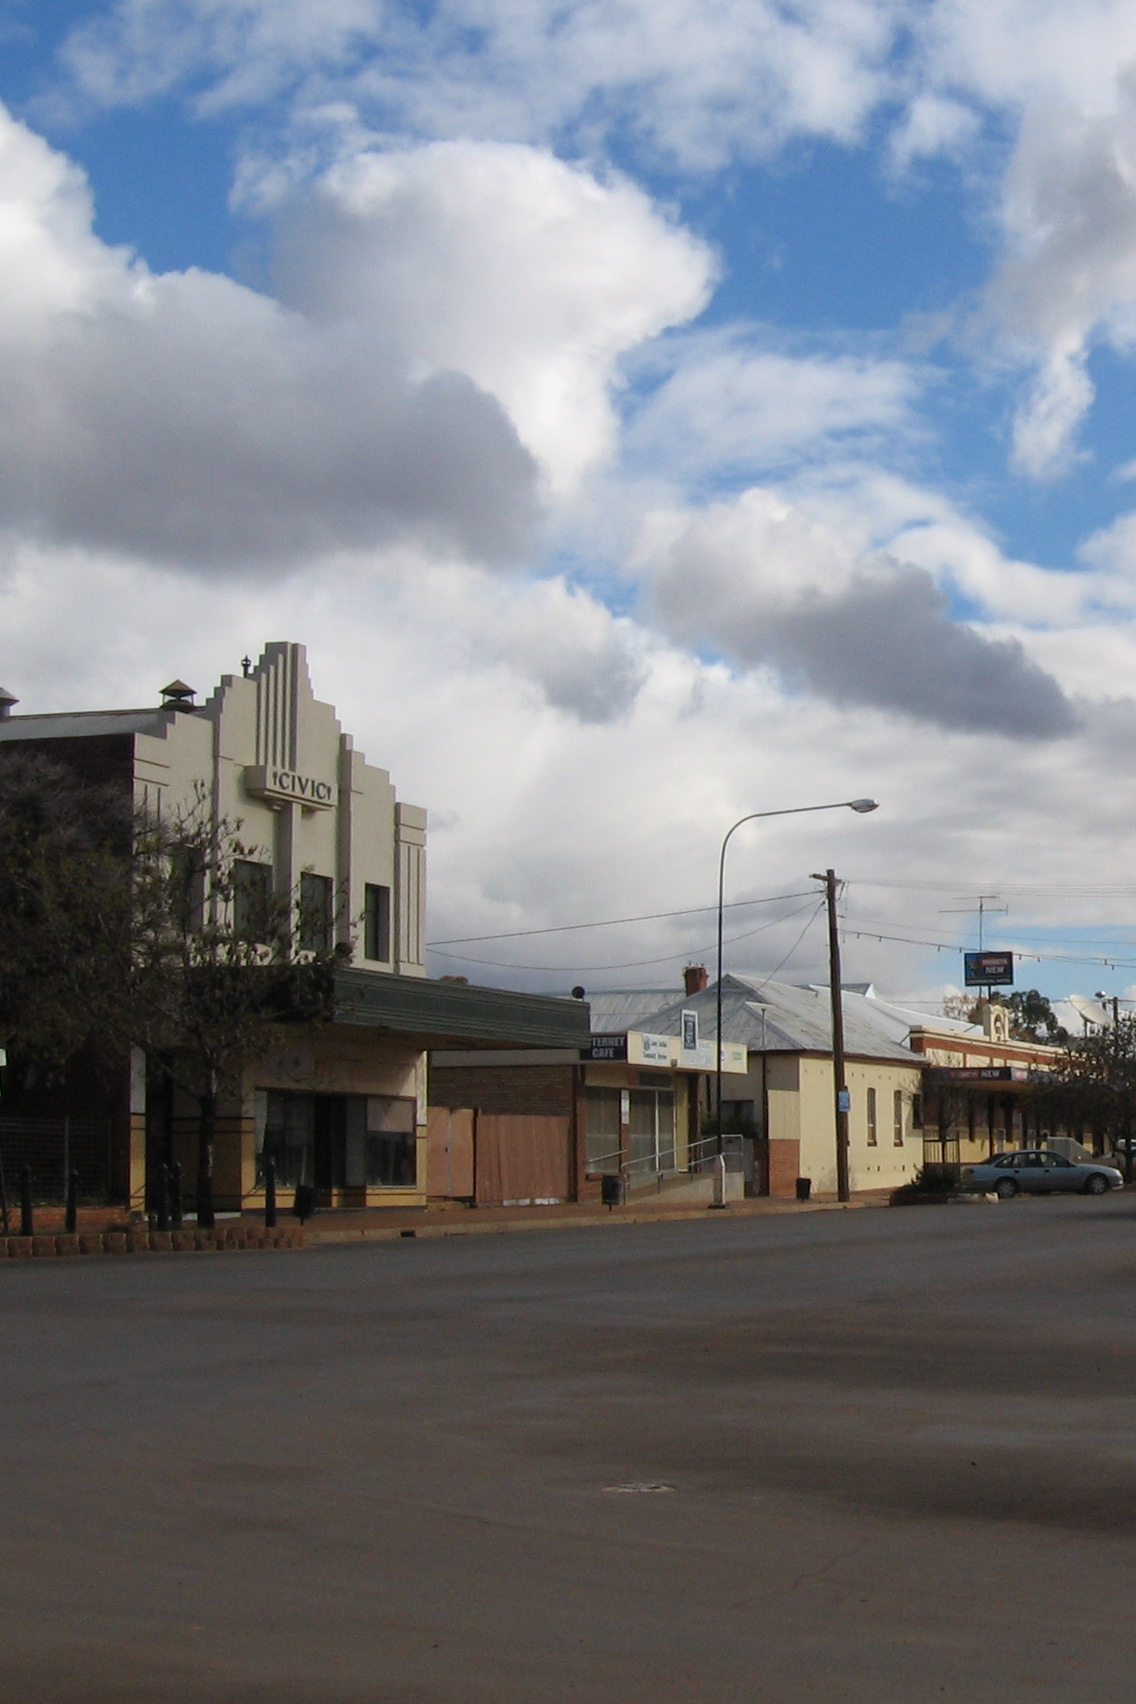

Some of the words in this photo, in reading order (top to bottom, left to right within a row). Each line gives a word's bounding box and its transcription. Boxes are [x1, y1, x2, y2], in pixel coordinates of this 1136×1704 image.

[279, 772, 327, 800] CIVIC
[985, 966, 1004, 974] NEW
[592, 1037, 624, 1047] TERNET
[592, 1048, 614, 1058] CAFE
